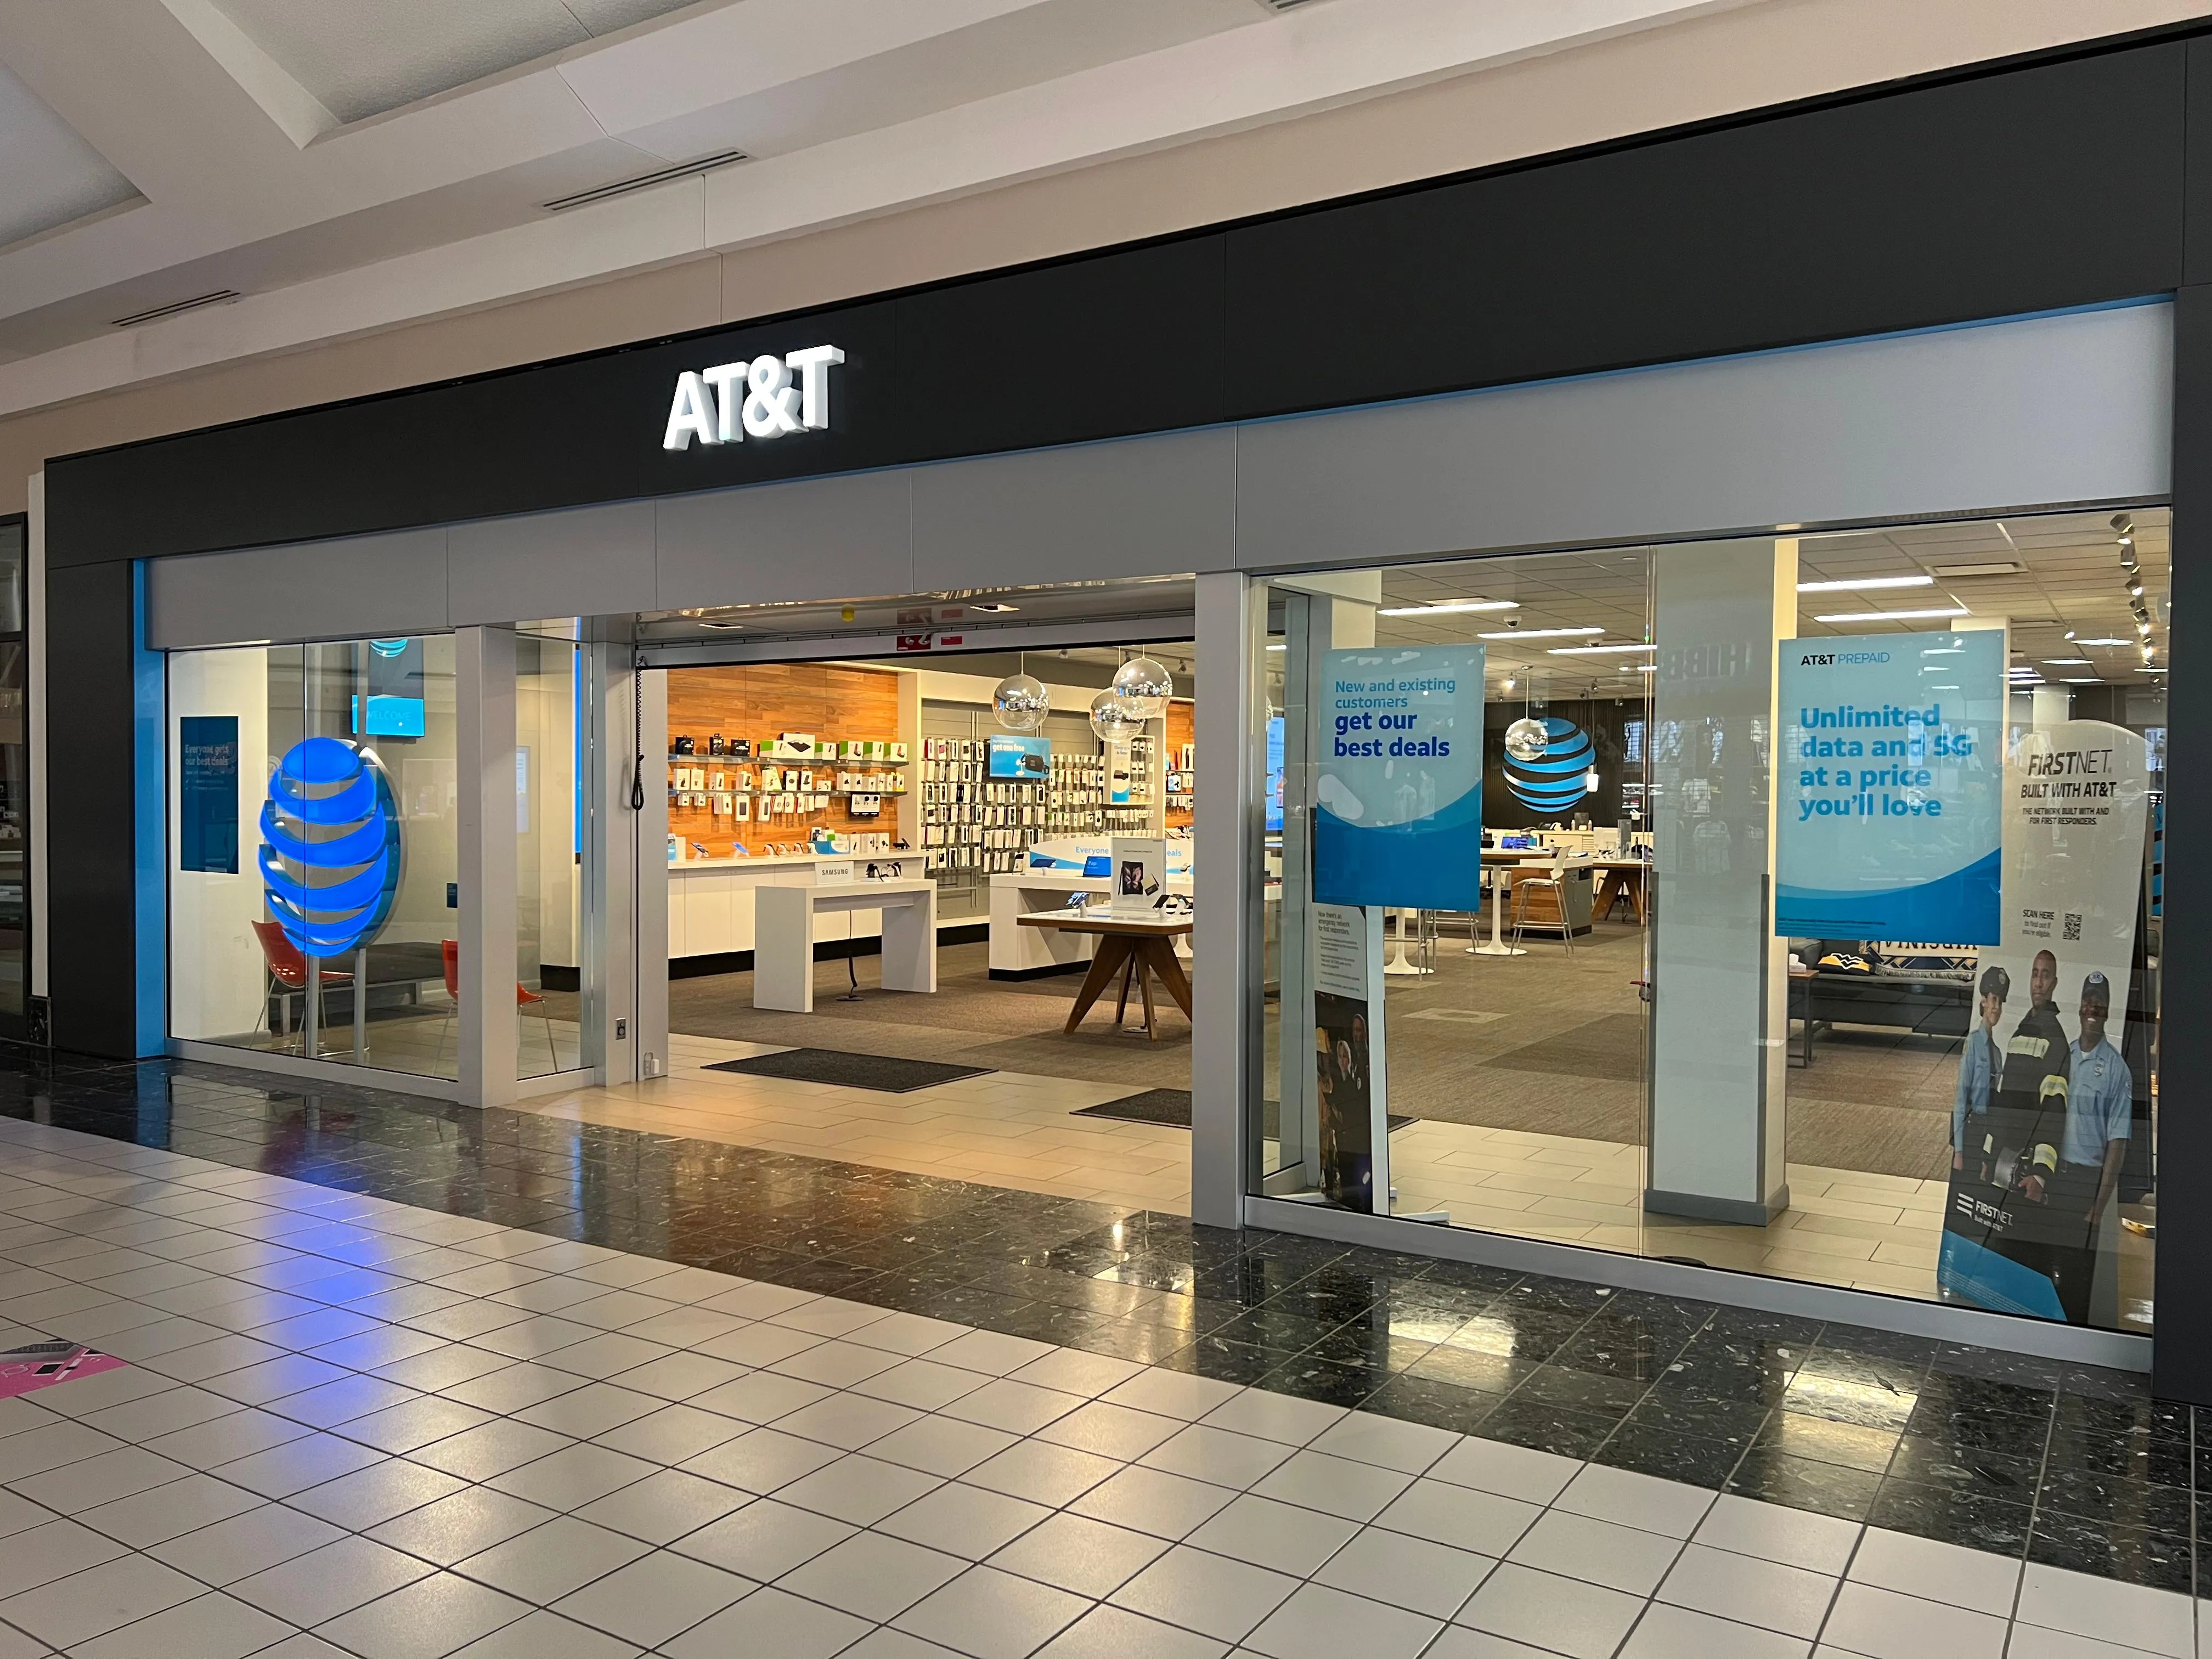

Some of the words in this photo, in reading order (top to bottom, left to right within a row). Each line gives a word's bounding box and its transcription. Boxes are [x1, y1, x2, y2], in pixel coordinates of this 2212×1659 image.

[663, 344, 845, 451] AT&T
[1801, 654, 1835, 665] AT&T
[1838, 652, 1890, 664] PREPAID
[1335, 681, 1365, 692] New
[1369, 679, 1394, 692] and
[1398, 678, 1455, 693] existing
[1335, 697, 1408, 708] customers
[1335, 712, 1372, 735] get
[1378, 714, 1417, 730] our
[1801, 703, 1940, 728] Unlimited
[1334, 737, 1383, 757] best
[1389, 736, 1450, 757] deals
[1801, 736, 1863, 757] data
[1871, 733, 1926, 757] and
[1934, 734, 1972, 757] 5G
[1799, 766, 1828, 786] at
[1836, 771, 1852, 786] a
[1860, 764, 1931, 792] price
[2021, 783, 2049, 798] BUILT
[2051, 783, 2081, 798] WITH
[2083, 782, 2117, 797] AT&T
[1798, 794, 1874, 821] you'll
[1882, 794, 1942, 816] love
[1076, 846, 1109, 855] Everyone
